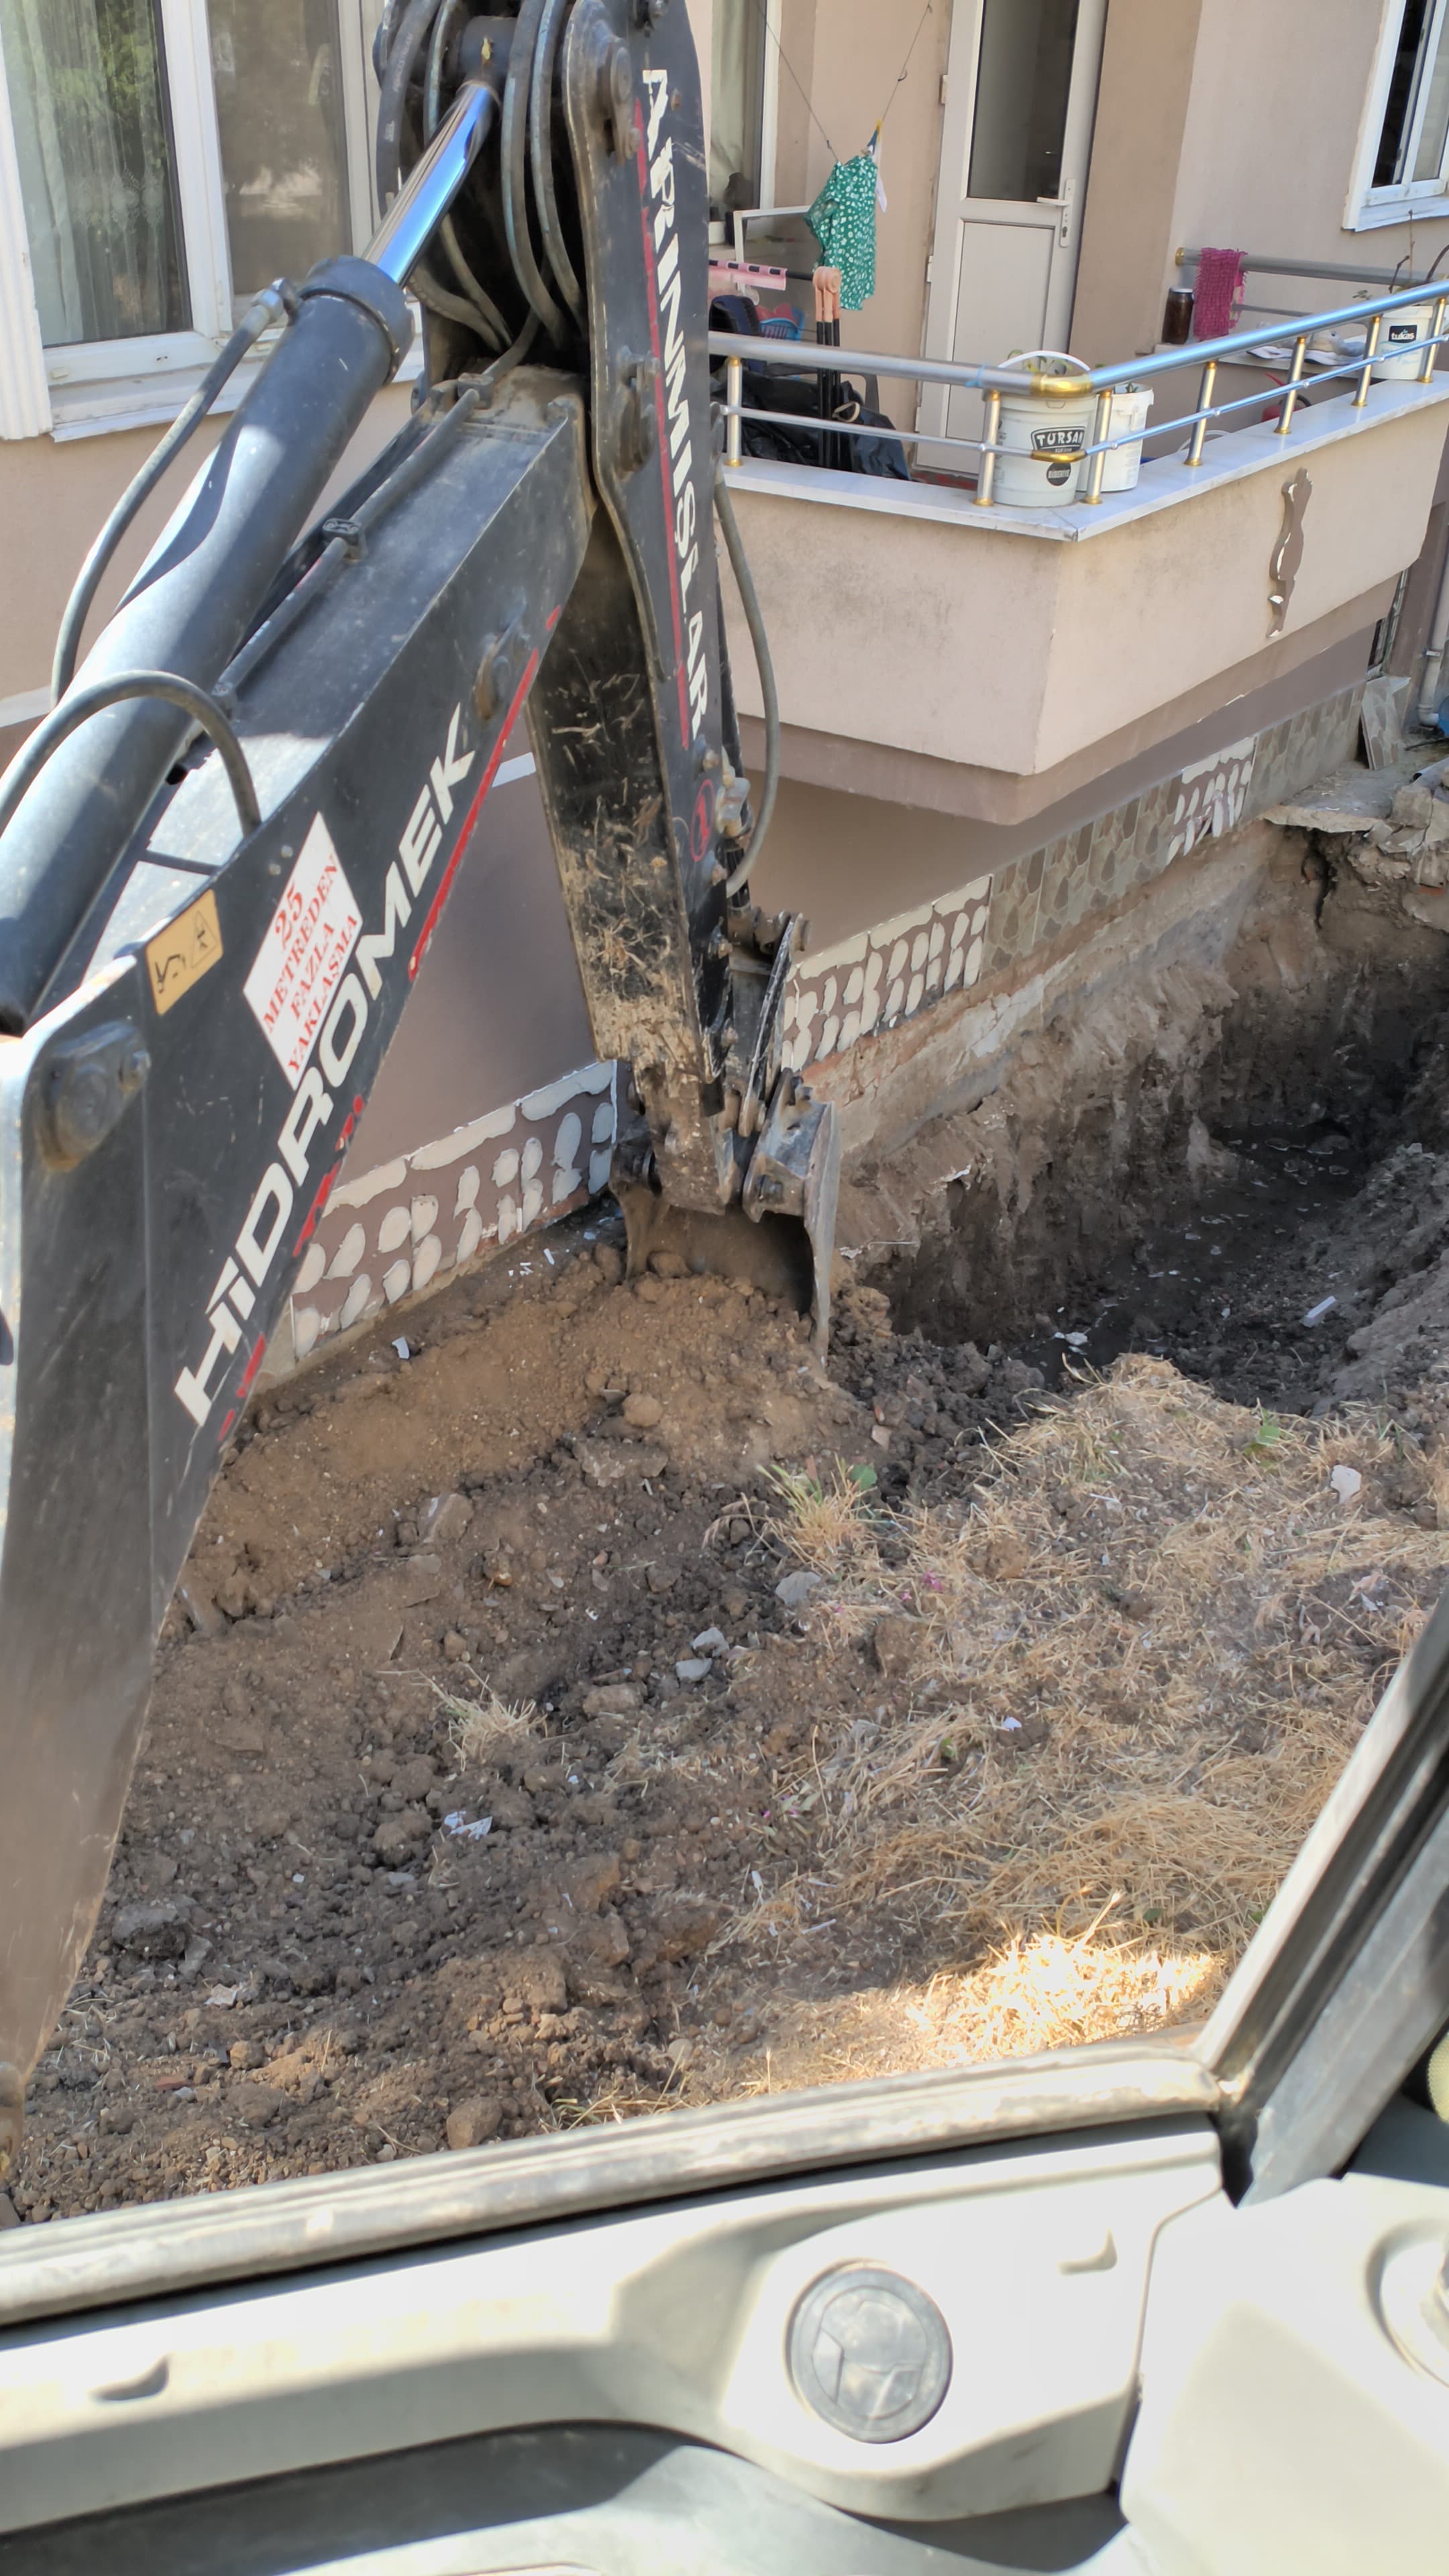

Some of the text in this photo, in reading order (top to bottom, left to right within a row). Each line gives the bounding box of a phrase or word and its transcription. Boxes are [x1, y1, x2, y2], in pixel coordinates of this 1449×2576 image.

[262, 853, 338, 1034] METREDEN
[274, 880, 303, 949] 25
[290, 921, 334, 1020] FAZLA
[288, 913, 358, 1074] YAKLAŞMA
